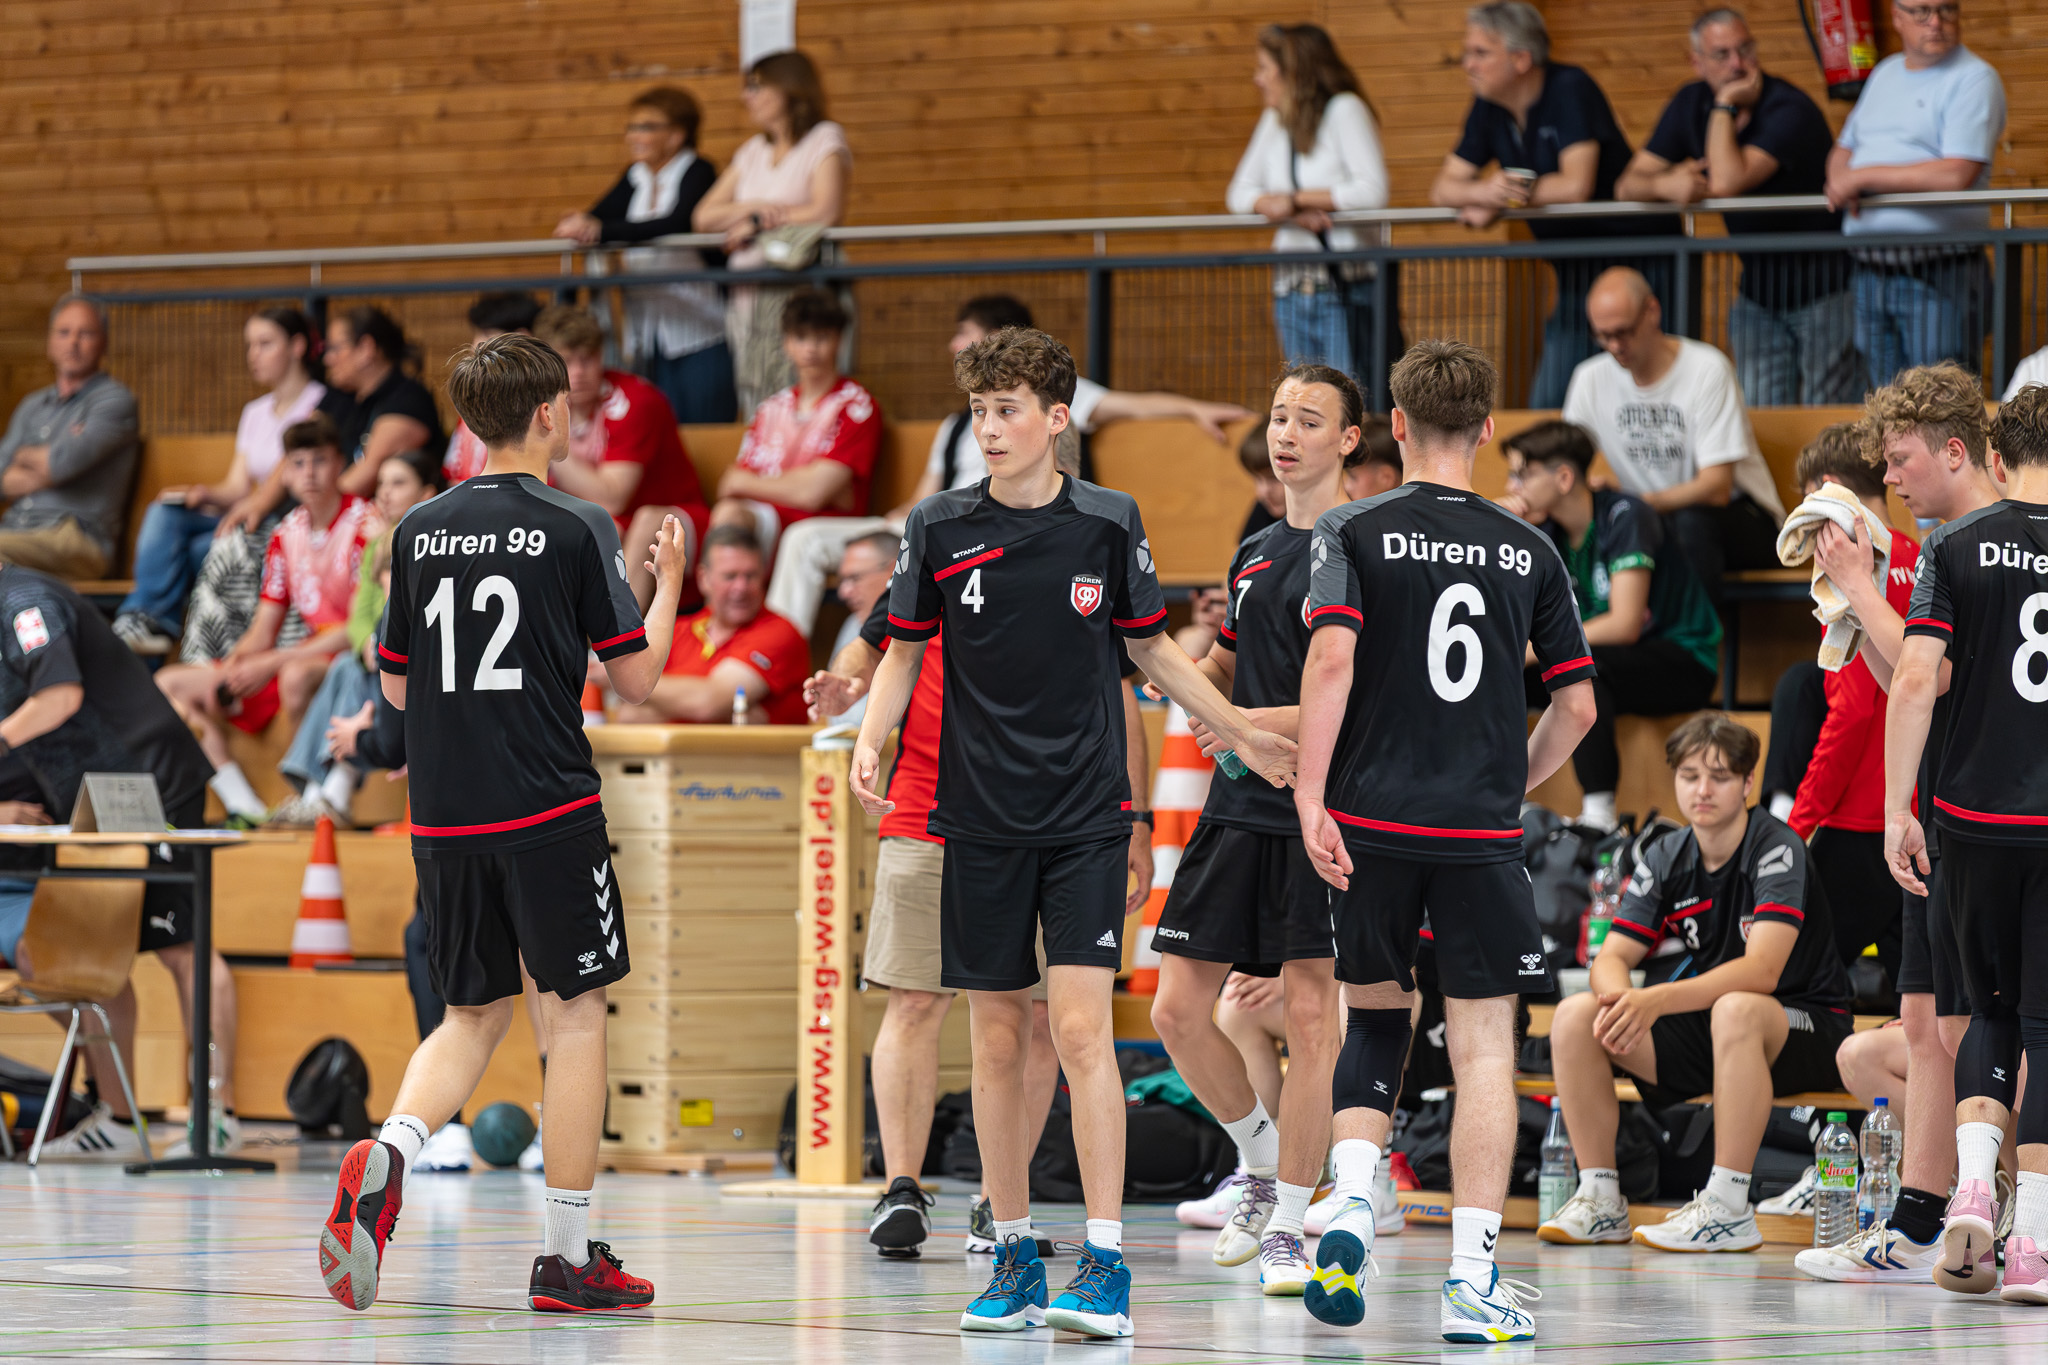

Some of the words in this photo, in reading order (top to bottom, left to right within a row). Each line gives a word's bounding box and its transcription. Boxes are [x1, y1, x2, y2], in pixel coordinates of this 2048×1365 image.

[414, 529, 497, 562] Düren
[506, 527, 547, 557] 99
[952, 543, 986, 560] STANNO
[1382, 532, 1486, 566] Düren
[1498, 543, 1532, 576] 99
[1979, 541, 2048, 575] Düre
[961, 568, 985, 614] 4
[1075, 576, 1102, 585] DÜREN
[1235, 580, 1253, 621] 7
[424, 575, 523, 693] 12
[1427, 582, 1486, 703] 6
[2012, 591, 2048, 703] 8
[1683, 916, 1700, 951] 3
[809, 774, 840, 1150] www.hsg-wesel.de
[1518, 968, 1545, 976] hummel
